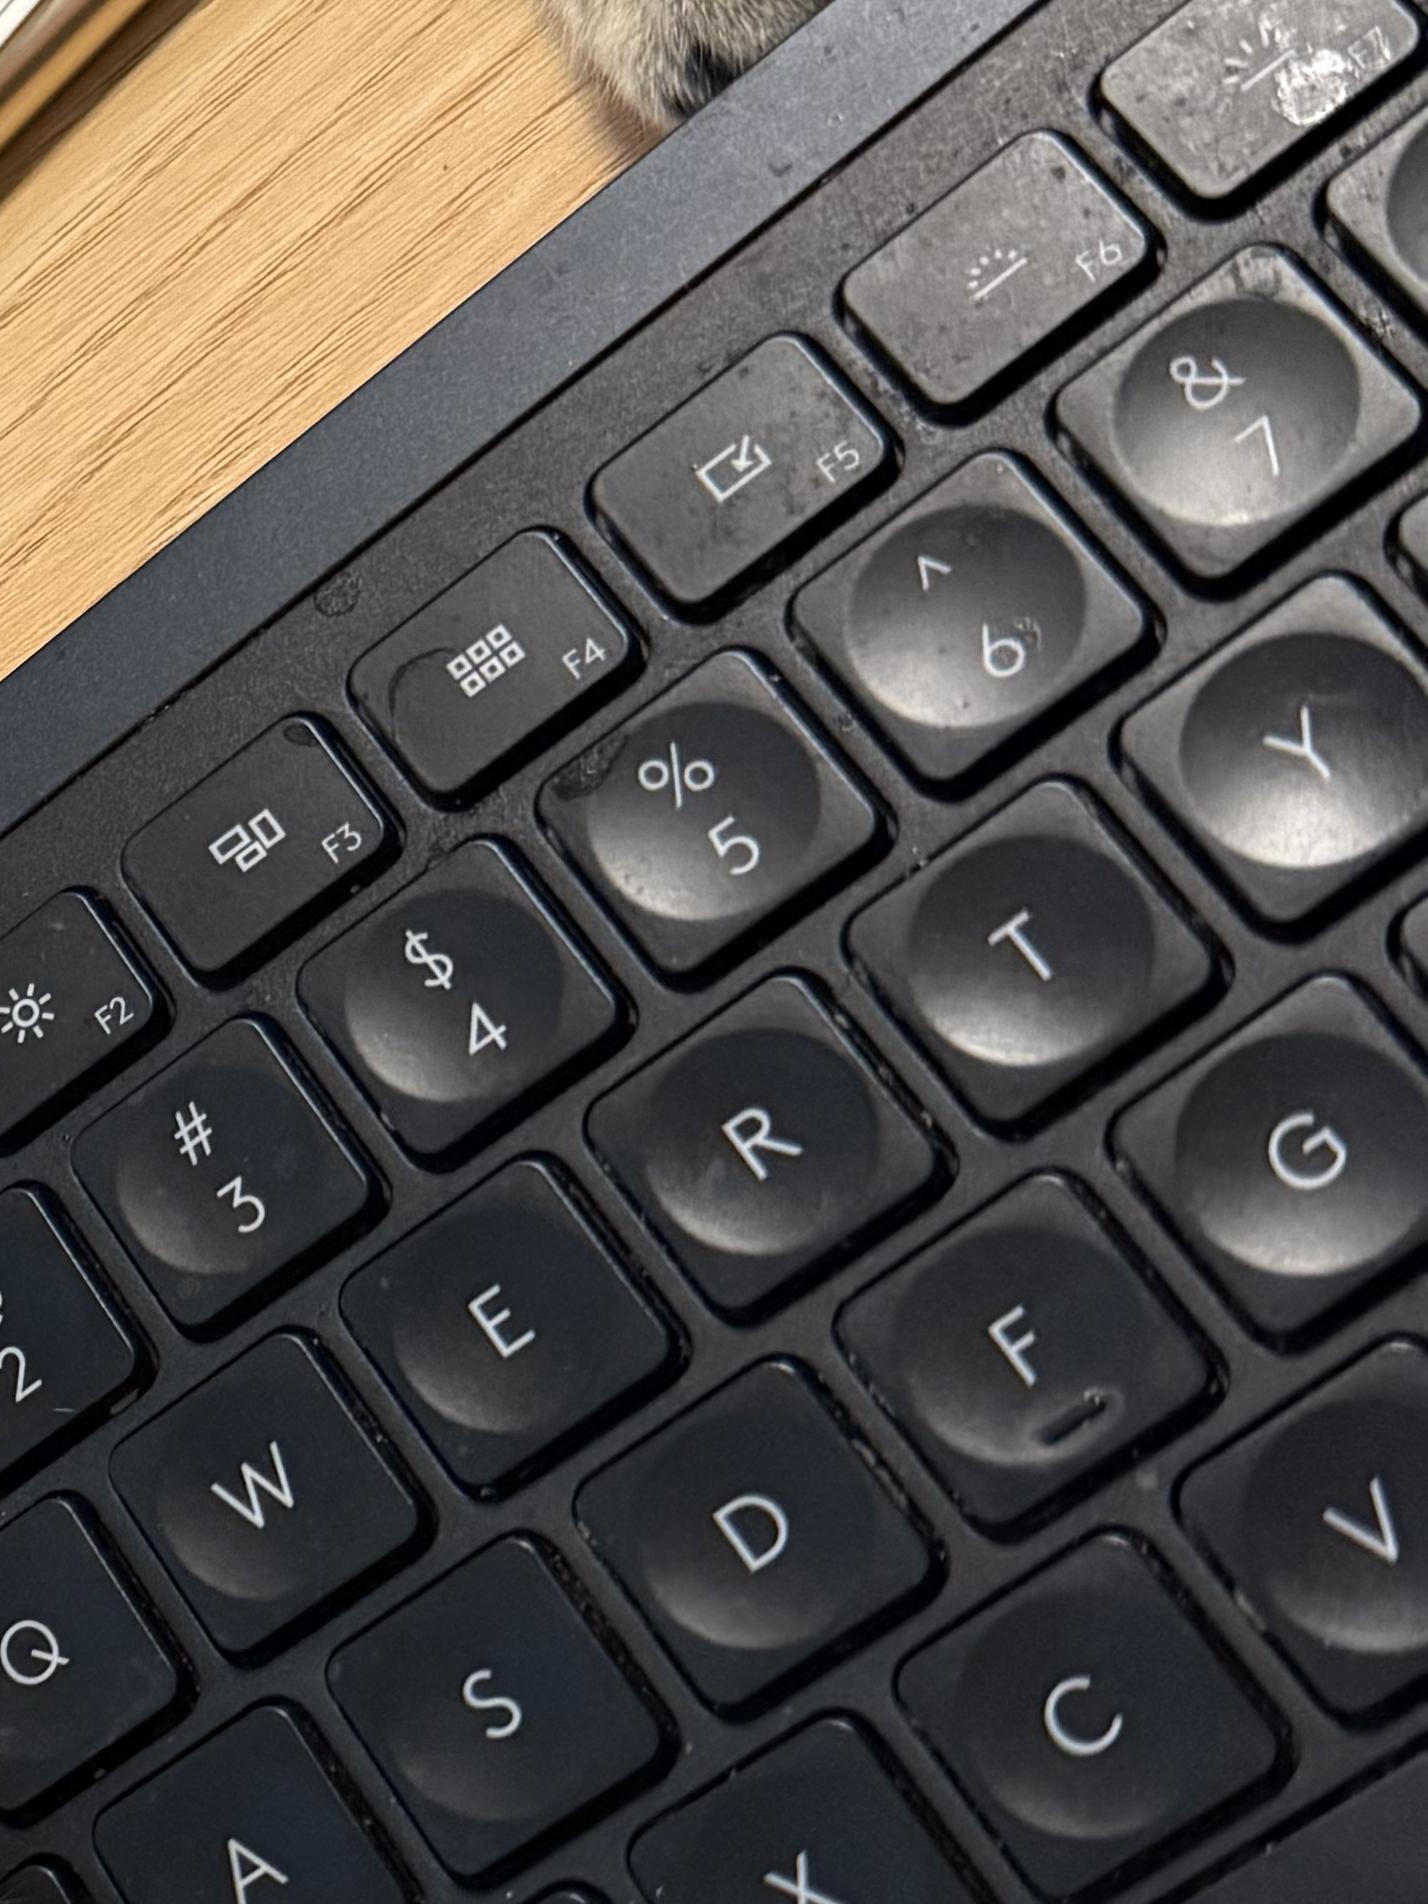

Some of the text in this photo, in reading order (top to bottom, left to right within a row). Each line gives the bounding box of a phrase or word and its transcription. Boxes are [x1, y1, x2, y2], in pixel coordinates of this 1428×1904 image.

[1348, 26, 1390, 70] F7
[1075, 239, 1123, 282] F6
[1170, 356, 1244, 409] &
[816, 441, 859, 483] F5
[1234, 416, 1278, 475] 7
[563, 638, 605, 679] F4
[983, 624, 1025, 677] 6
[1264, 706, 1330, 778] Y
[639, 742, 714, 807] %
[322, 823, 361, 863] F3
[709, 816, 759, 874] 5
[405, 931, 453, 989] $
[989, 912, 1050, 979] T
[95, 997, 133, 1034] F2
[469, 1003, 506, 1054] 4
[175, 1102, 212, 1165] #
[723, 1108, 801, 1179] R
[1269, 1113, 1346, 1188] G
[217, 1176, 265, 1232] 3
[469, 1285, 534, 1357] E
[989, 1306, 1035, 1385] F
[211, 1442, 293, 1528] W
[714, 1496, 787, 1571] D
[1324, 1478, 1397, 1561] V
[0, 1620, 69, 1684] Q
[464, 1670, 521, 1738] S
[1045, 1678, 1122, 1755] C
